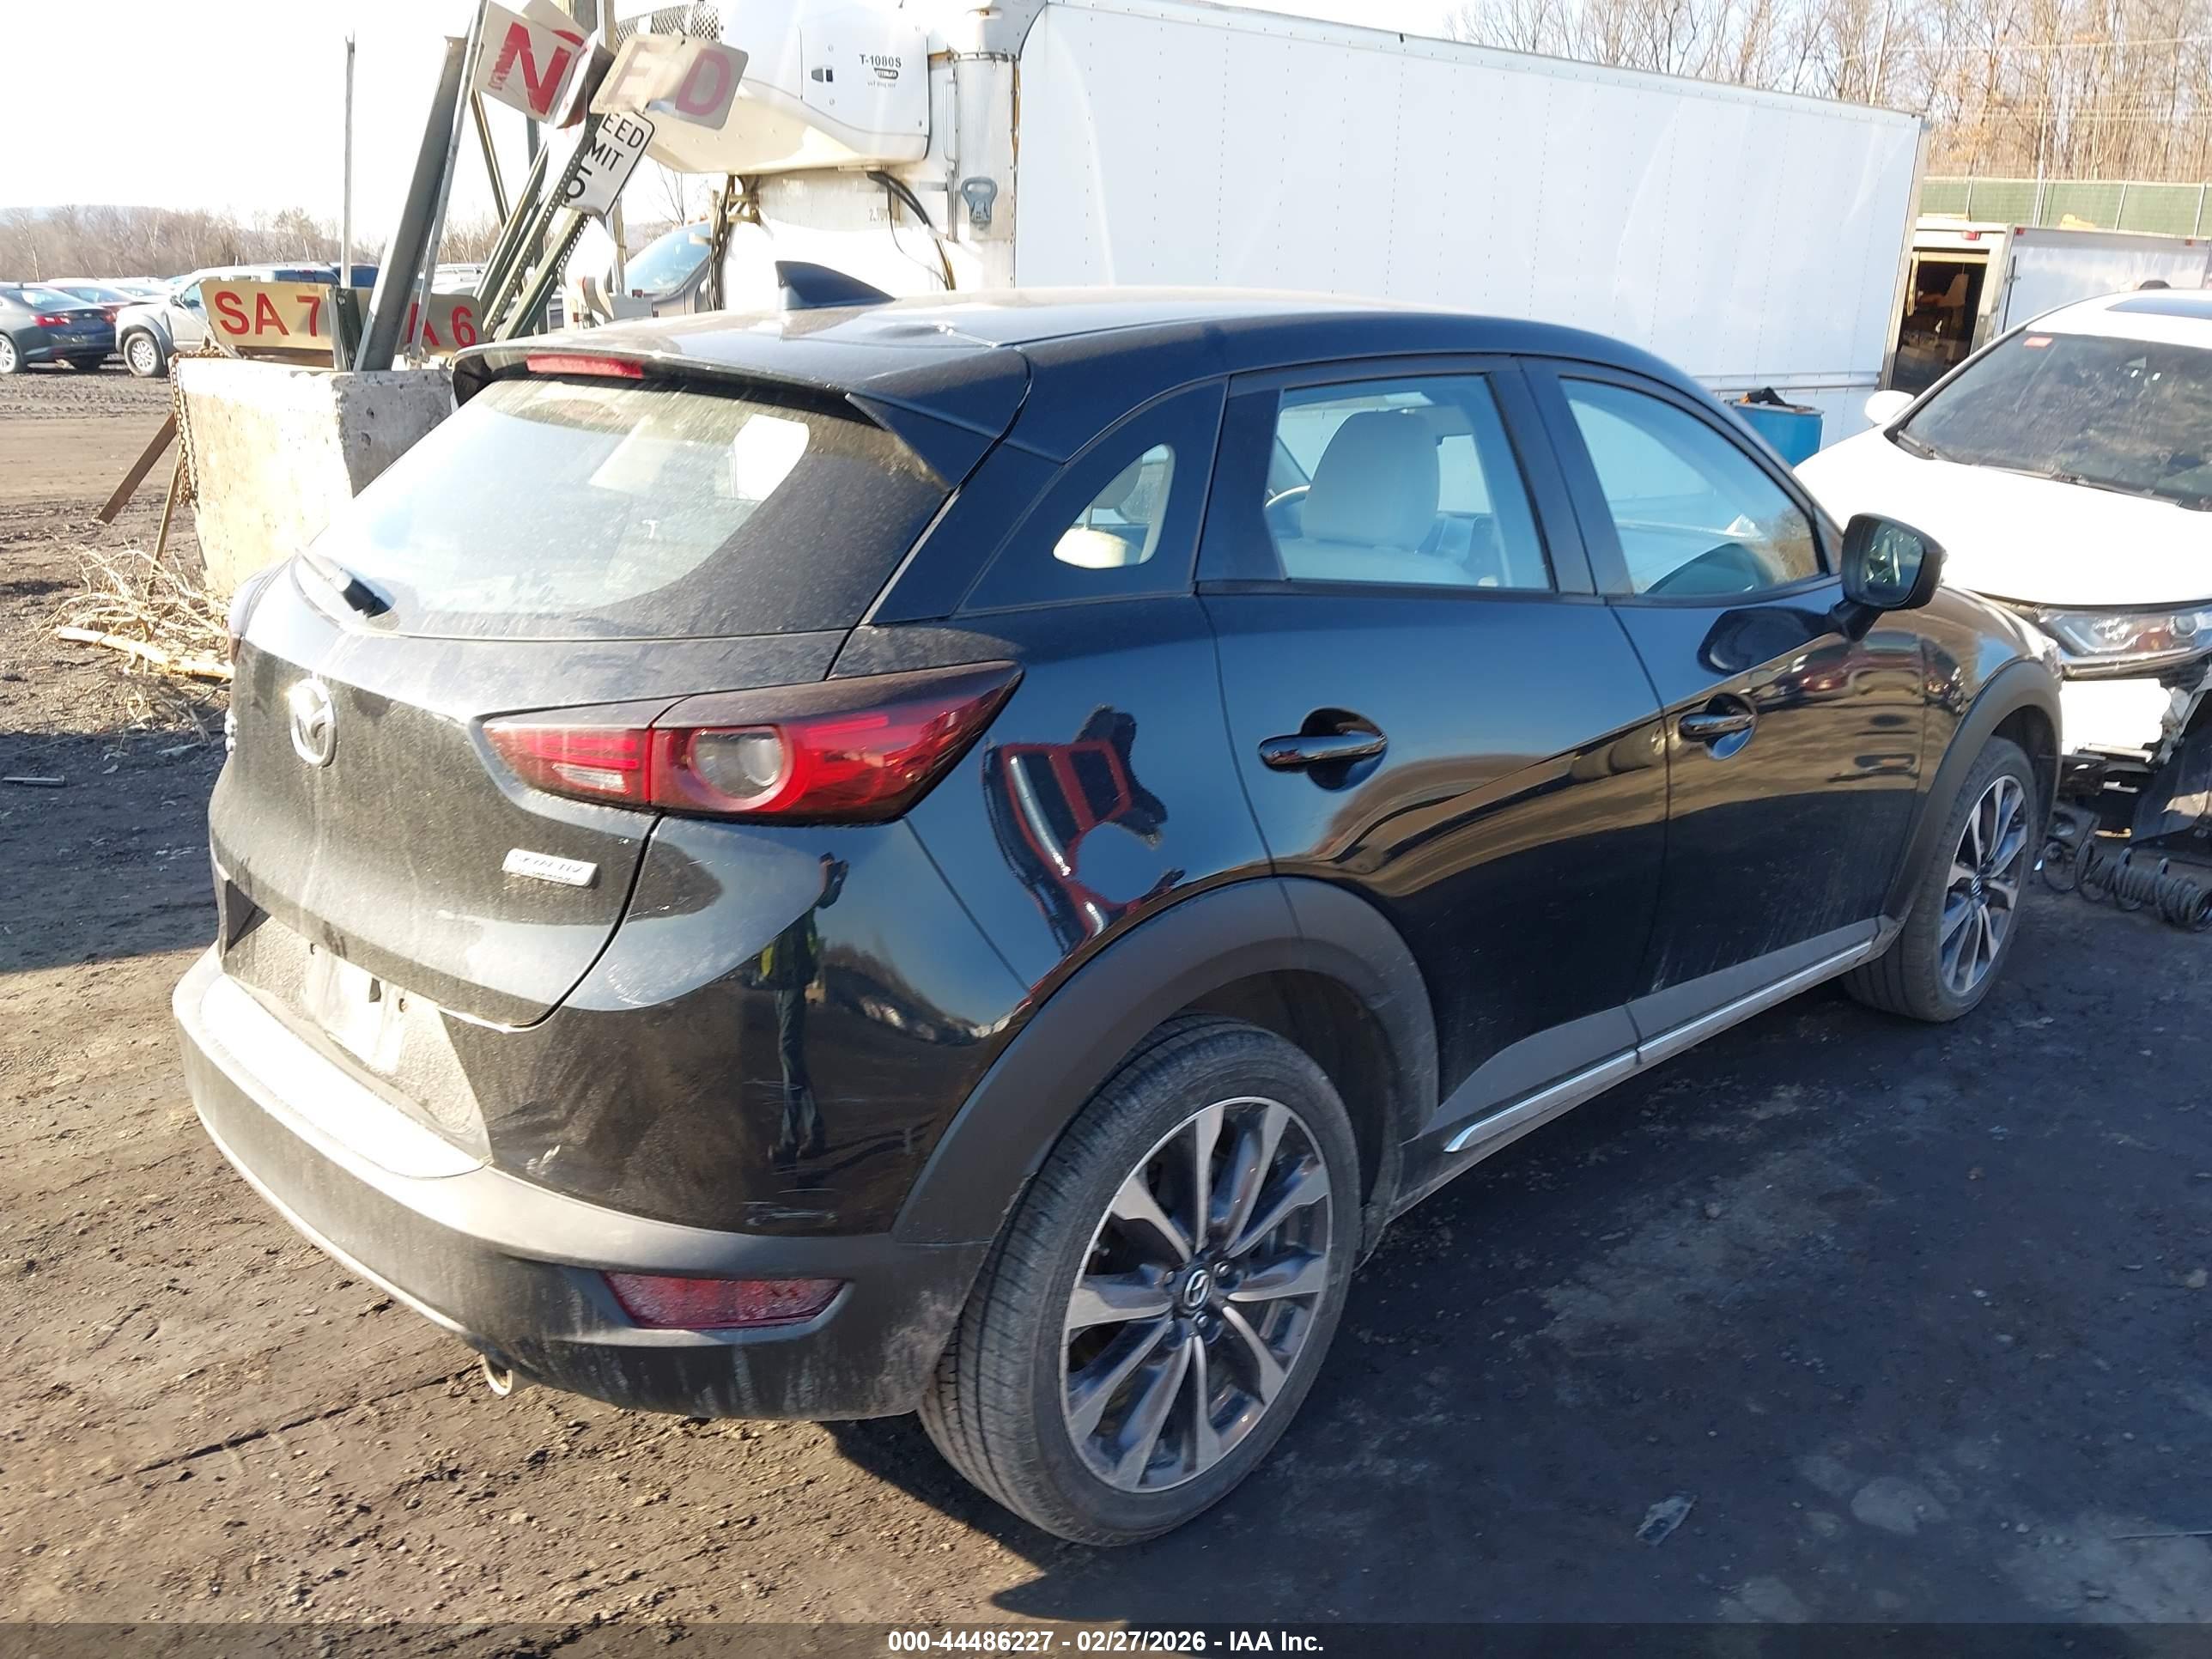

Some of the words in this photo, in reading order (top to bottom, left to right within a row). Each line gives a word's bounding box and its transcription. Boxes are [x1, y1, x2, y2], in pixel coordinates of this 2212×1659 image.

[859, 53, 902, 69] T-1080S
[215, 291, 289, 337] SA
[296, 295, 321, 337] 7
[452, 306, 477, 348] 6
